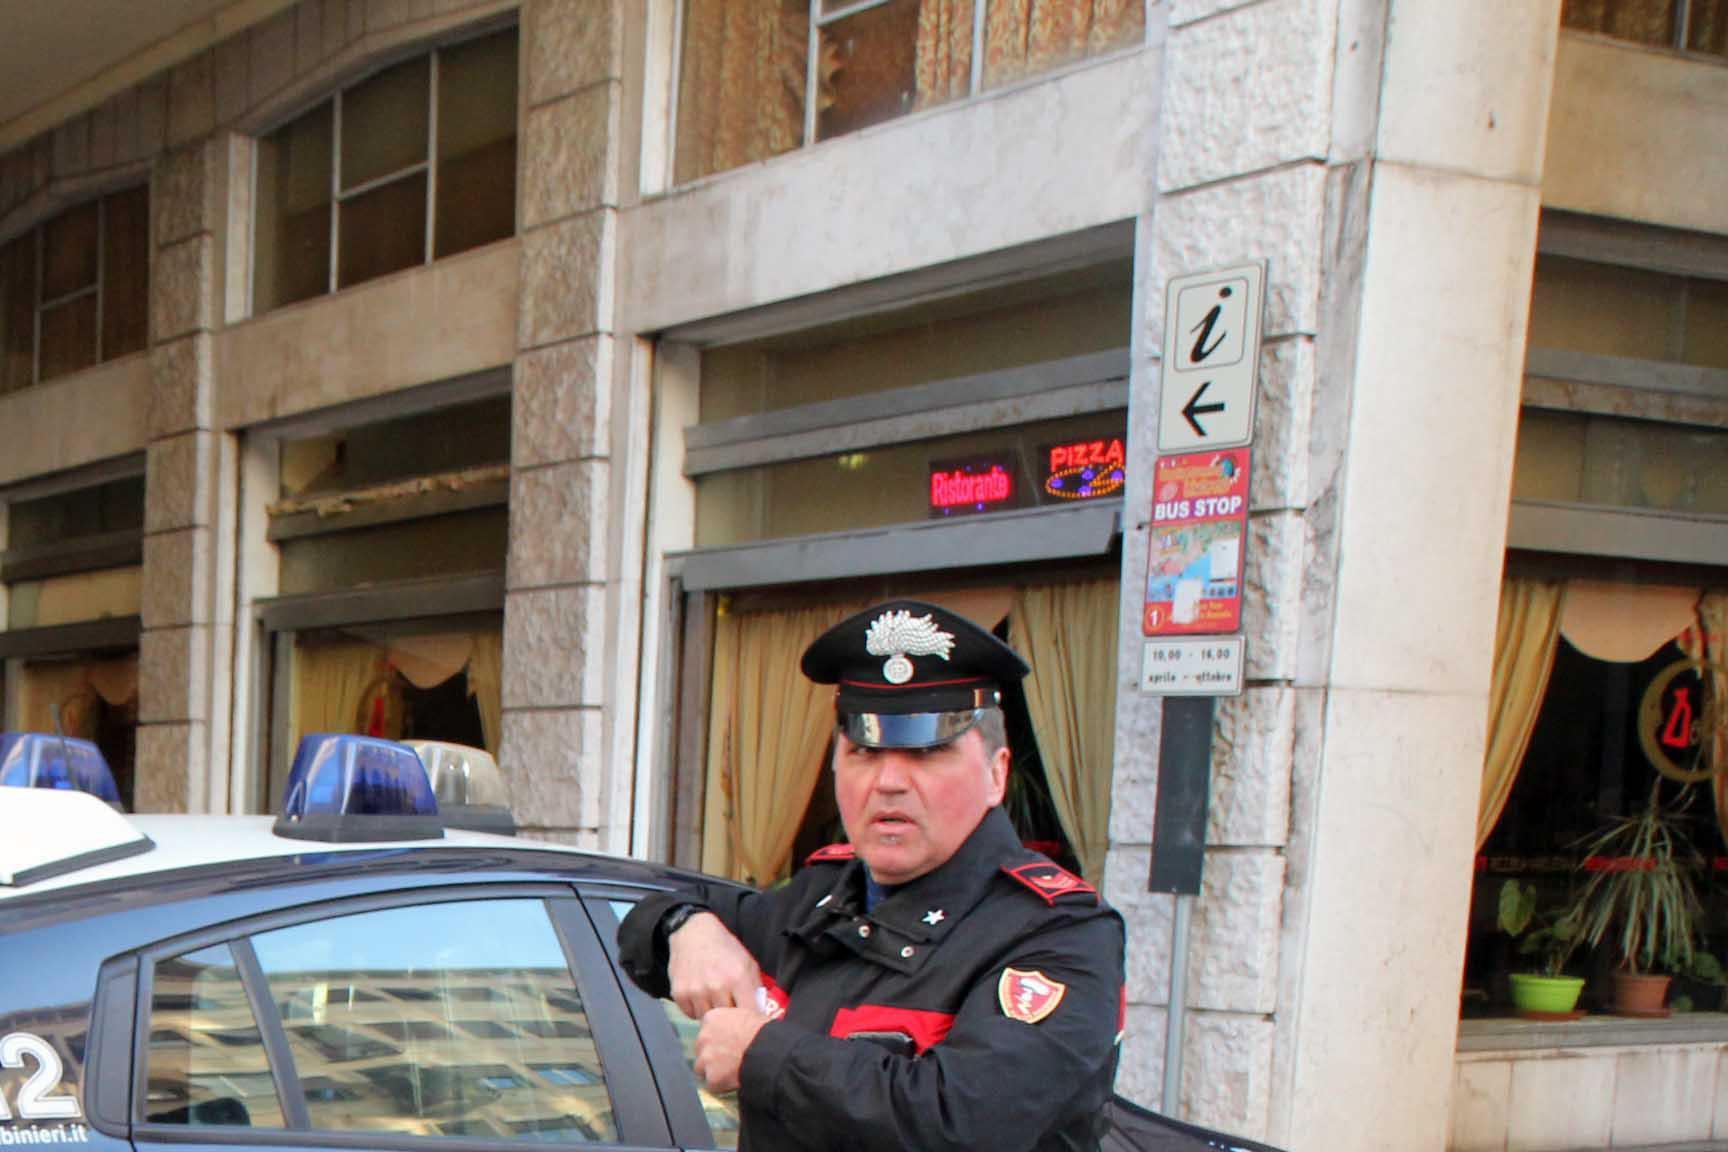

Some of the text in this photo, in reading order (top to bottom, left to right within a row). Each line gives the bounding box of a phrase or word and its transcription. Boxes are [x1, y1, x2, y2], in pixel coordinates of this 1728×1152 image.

[1050, 439, 1124, 473] PIZZA
[932, 465, 1011, 507] Ristorante
[1154, 495, 1242, 521] BUS STOP
